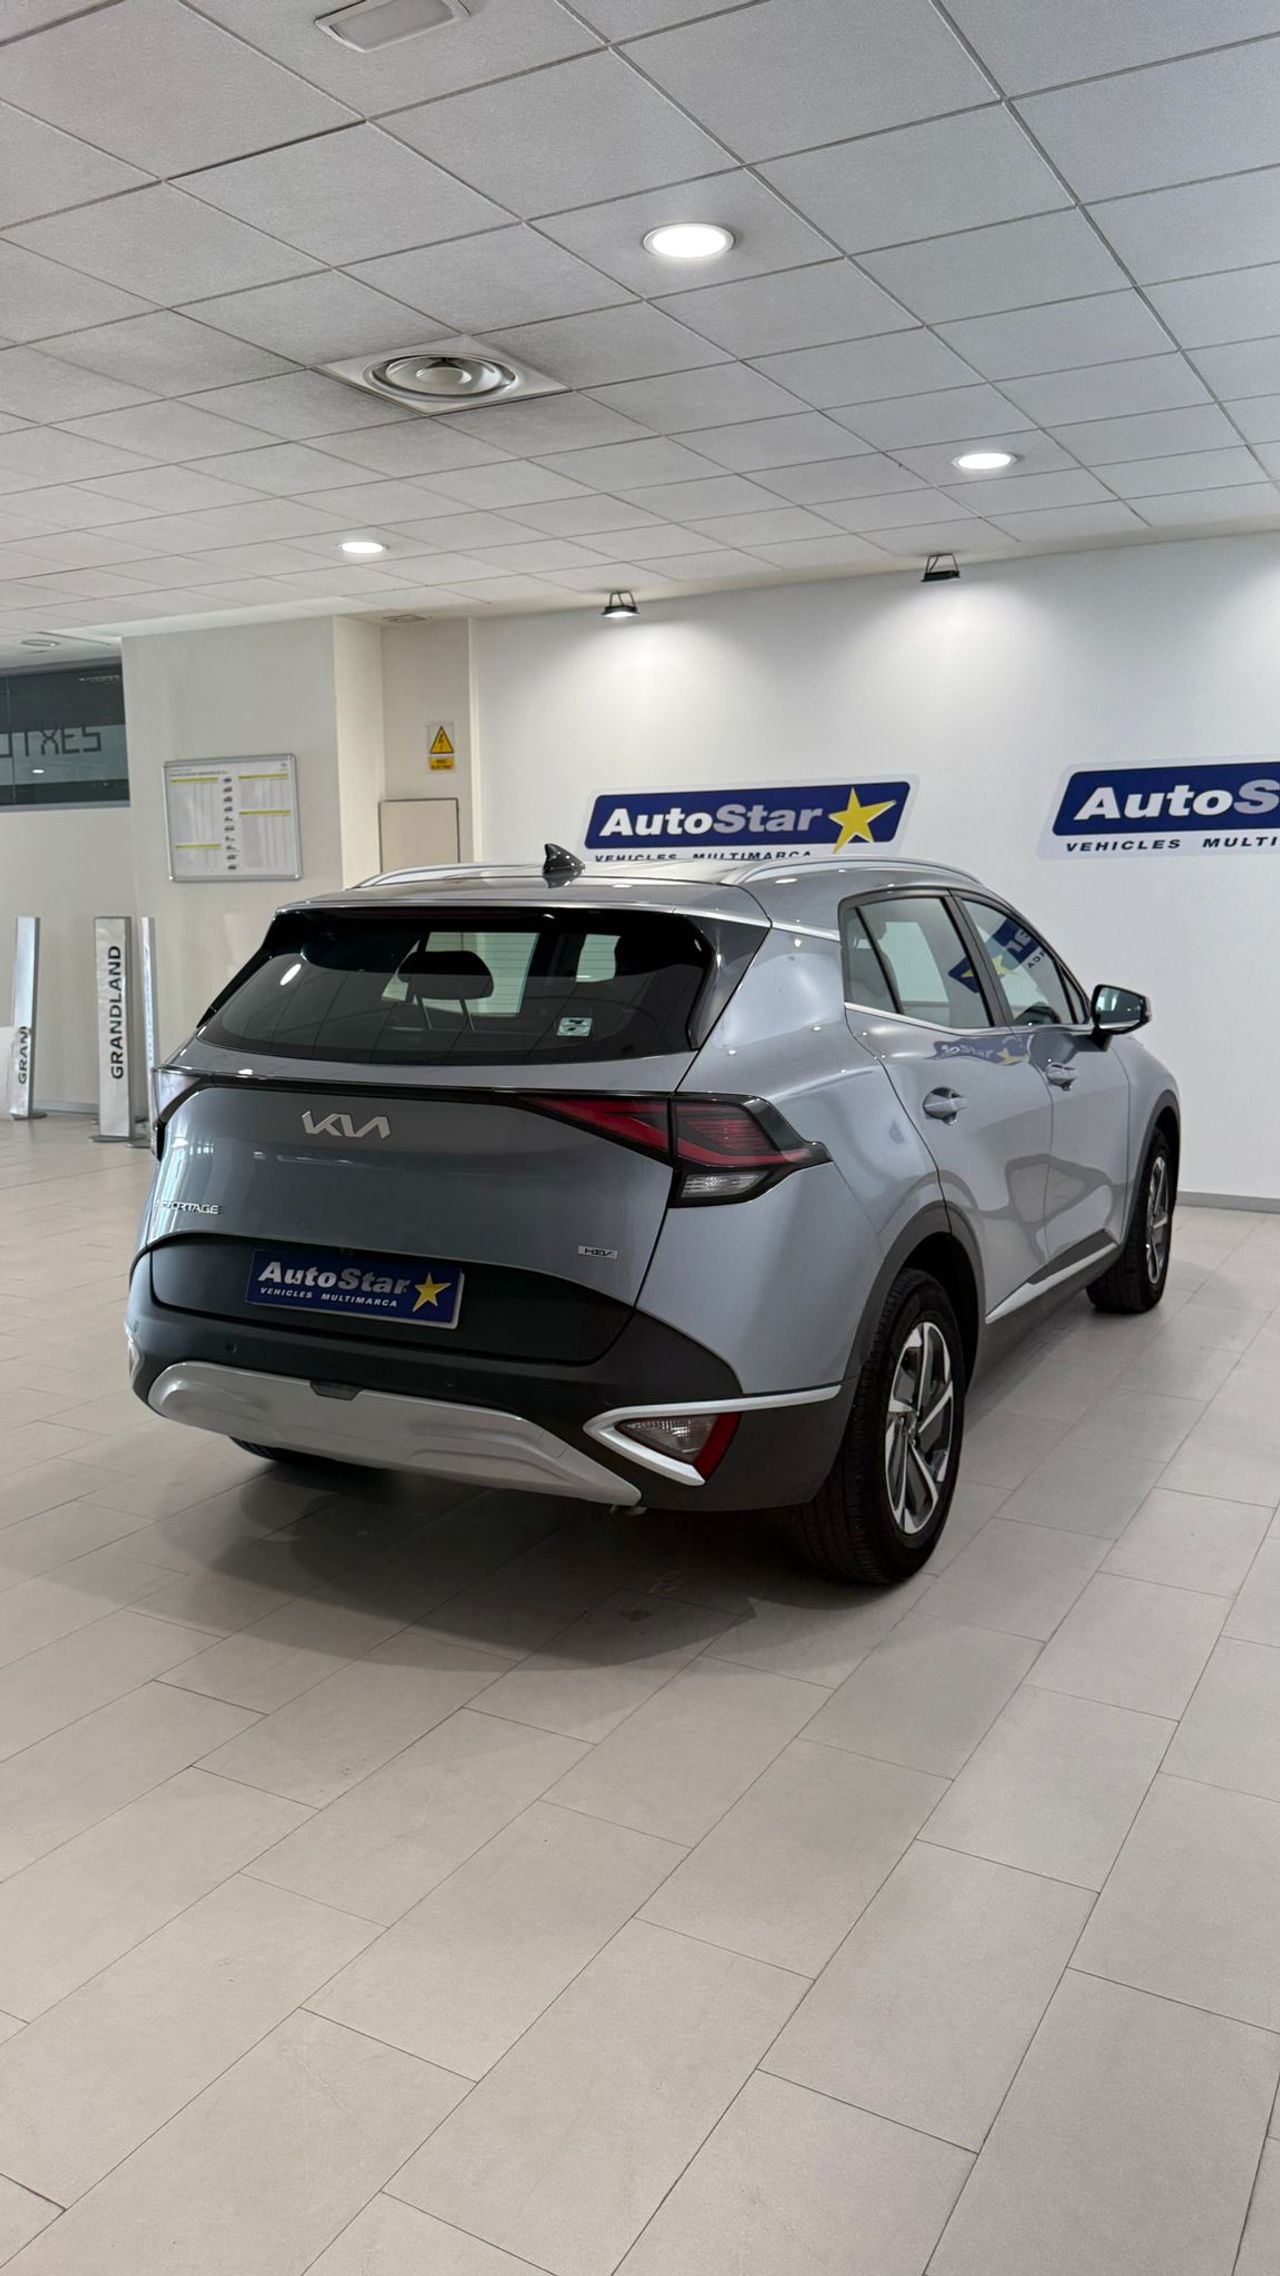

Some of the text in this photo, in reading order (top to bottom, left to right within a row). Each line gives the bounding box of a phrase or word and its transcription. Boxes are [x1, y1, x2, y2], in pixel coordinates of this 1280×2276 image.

[1073, 778, 1280, 821] AutoS
[599, 803, 821, 837] AutoStar
[1066, 836, 1277, 852] VEHICLES MULTI
[108, 945, 124, 1080] GRANDLAND
[302, 1110, 391, 1139] KIA
[258, 1261, 412, 1295] AutoStar
[260, 1287, 398, 1308] VEHICLES MULTIMARCA
